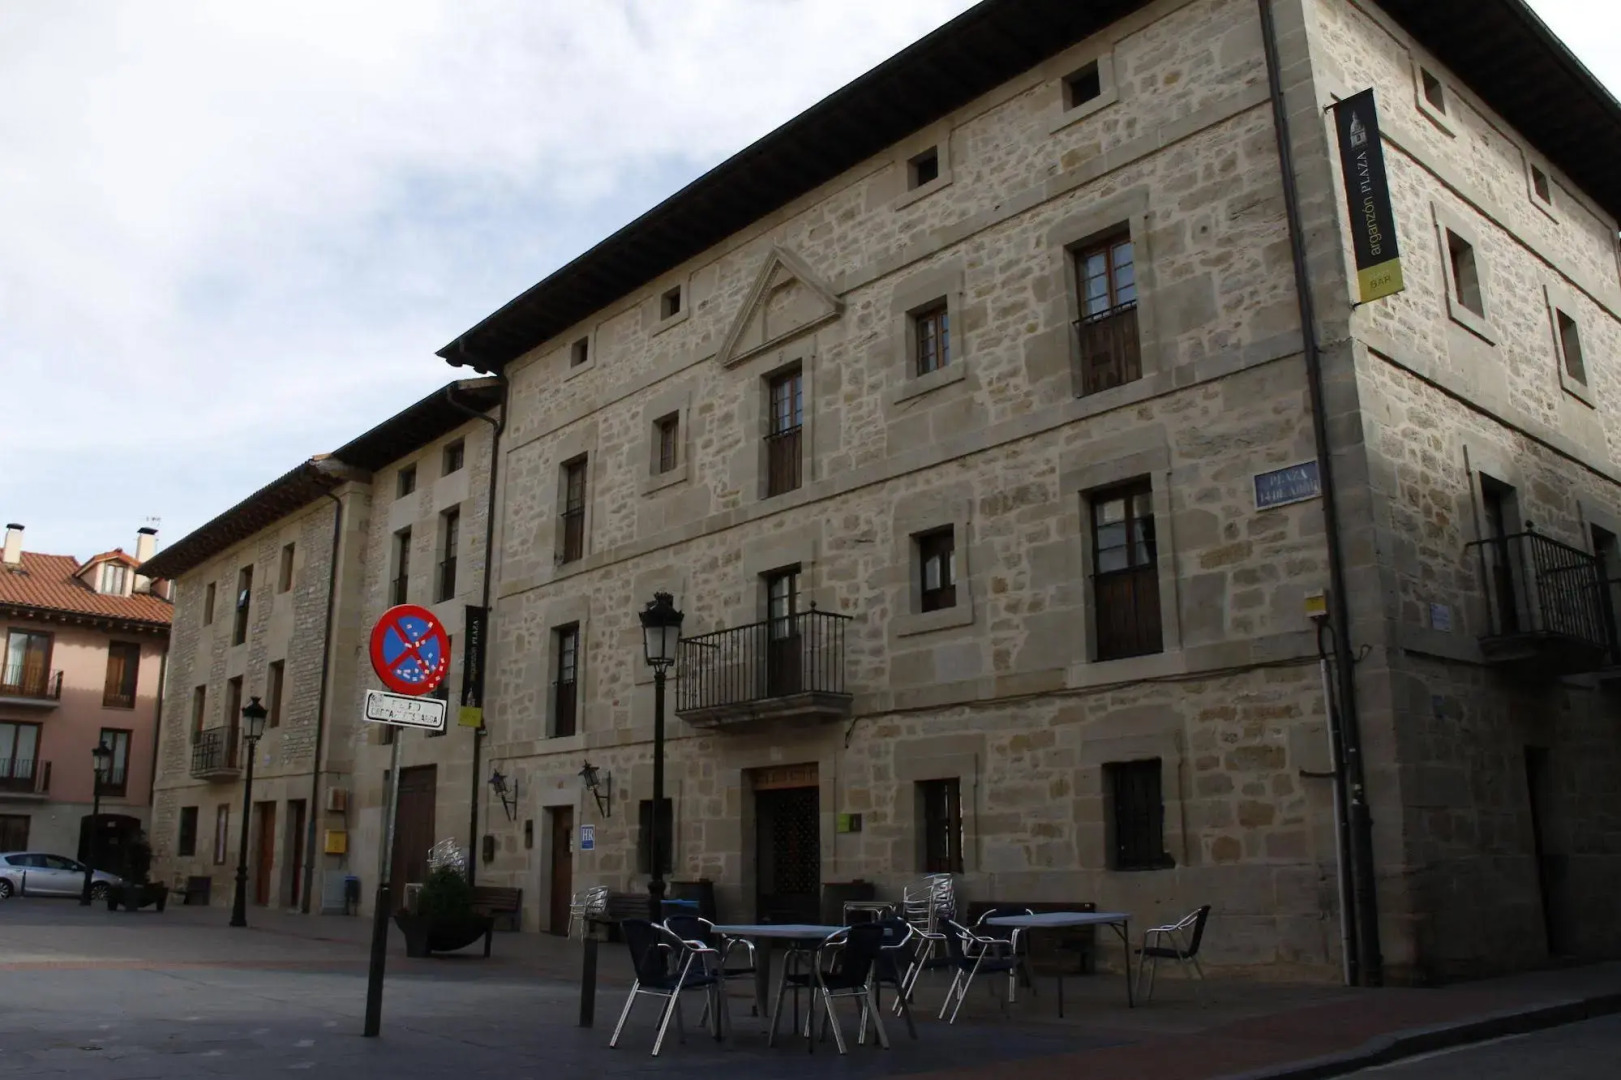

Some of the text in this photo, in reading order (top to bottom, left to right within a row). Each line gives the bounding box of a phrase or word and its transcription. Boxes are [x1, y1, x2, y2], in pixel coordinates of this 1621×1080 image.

[1356, 151, 1382, 256] arganzón PLAZA
[1370, 275, 1392, 290] BAR
